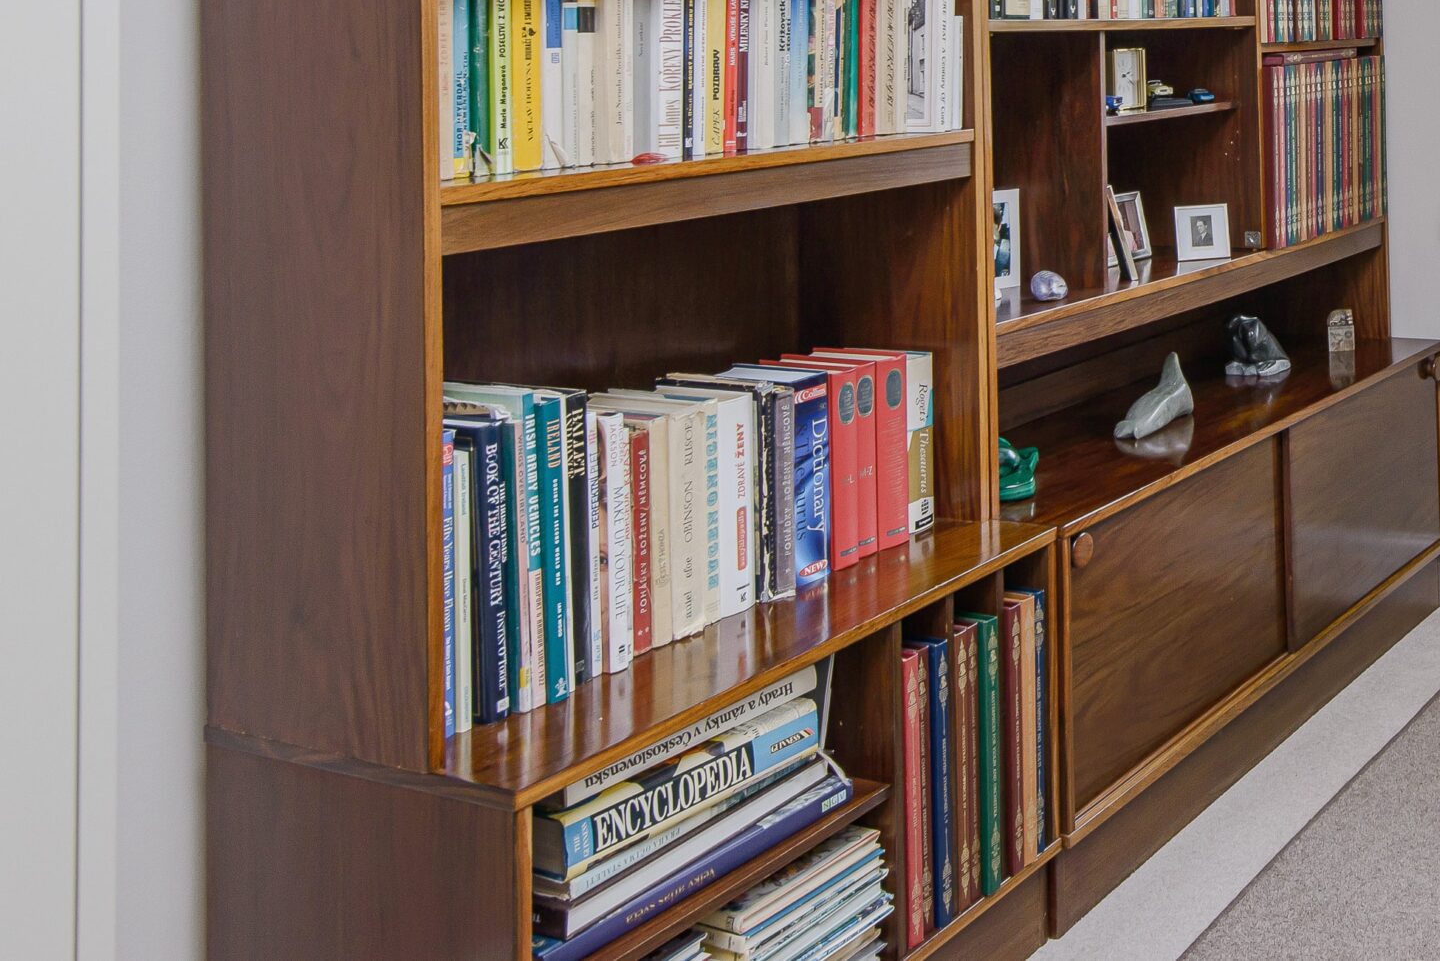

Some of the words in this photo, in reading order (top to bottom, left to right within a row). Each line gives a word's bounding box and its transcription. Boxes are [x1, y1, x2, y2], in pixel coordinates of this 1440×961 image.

[739, 11, 749, 52] MILENKY
[915, 383, 928, 423] Roget's
[525, 413, 536, 450] IRISH
[546, 418, 561, 468] IRELAND
[572, 408, 585, 476] BALLET
[734, 422, 745, 458] ŽENY
[486, 443, 498, 484] BOOK
[527, 454, 538, 491] ARMY
[735, 461, 746, 499] ZDRAVÉ
[807, 414, 828, 532] Dictionary
[919, 430, 929, 494] Thesaurus
[487, 486, 499, 505] OF
[613, 486, 624, 525] MAKE
[683, 480, 694, 543] OBINSON
[488, 507, 500, 538] THE
[528, 496, 540, 557] VEHICLES
[614, 529, 625, 548] UP
[489, 541, 502, 608] CENTURY
[614, 550, 626, 590] YOUR
[804, 562, 825, 576] NEW
[615, 592, 627, 620] LIFE
[748, 701, 756, 711] a
[757, 681, 794, 708] Hrady
[705, 704, 746, 732] zámky
[595, 746, 753, 851] ENCYCLOPEDIA
